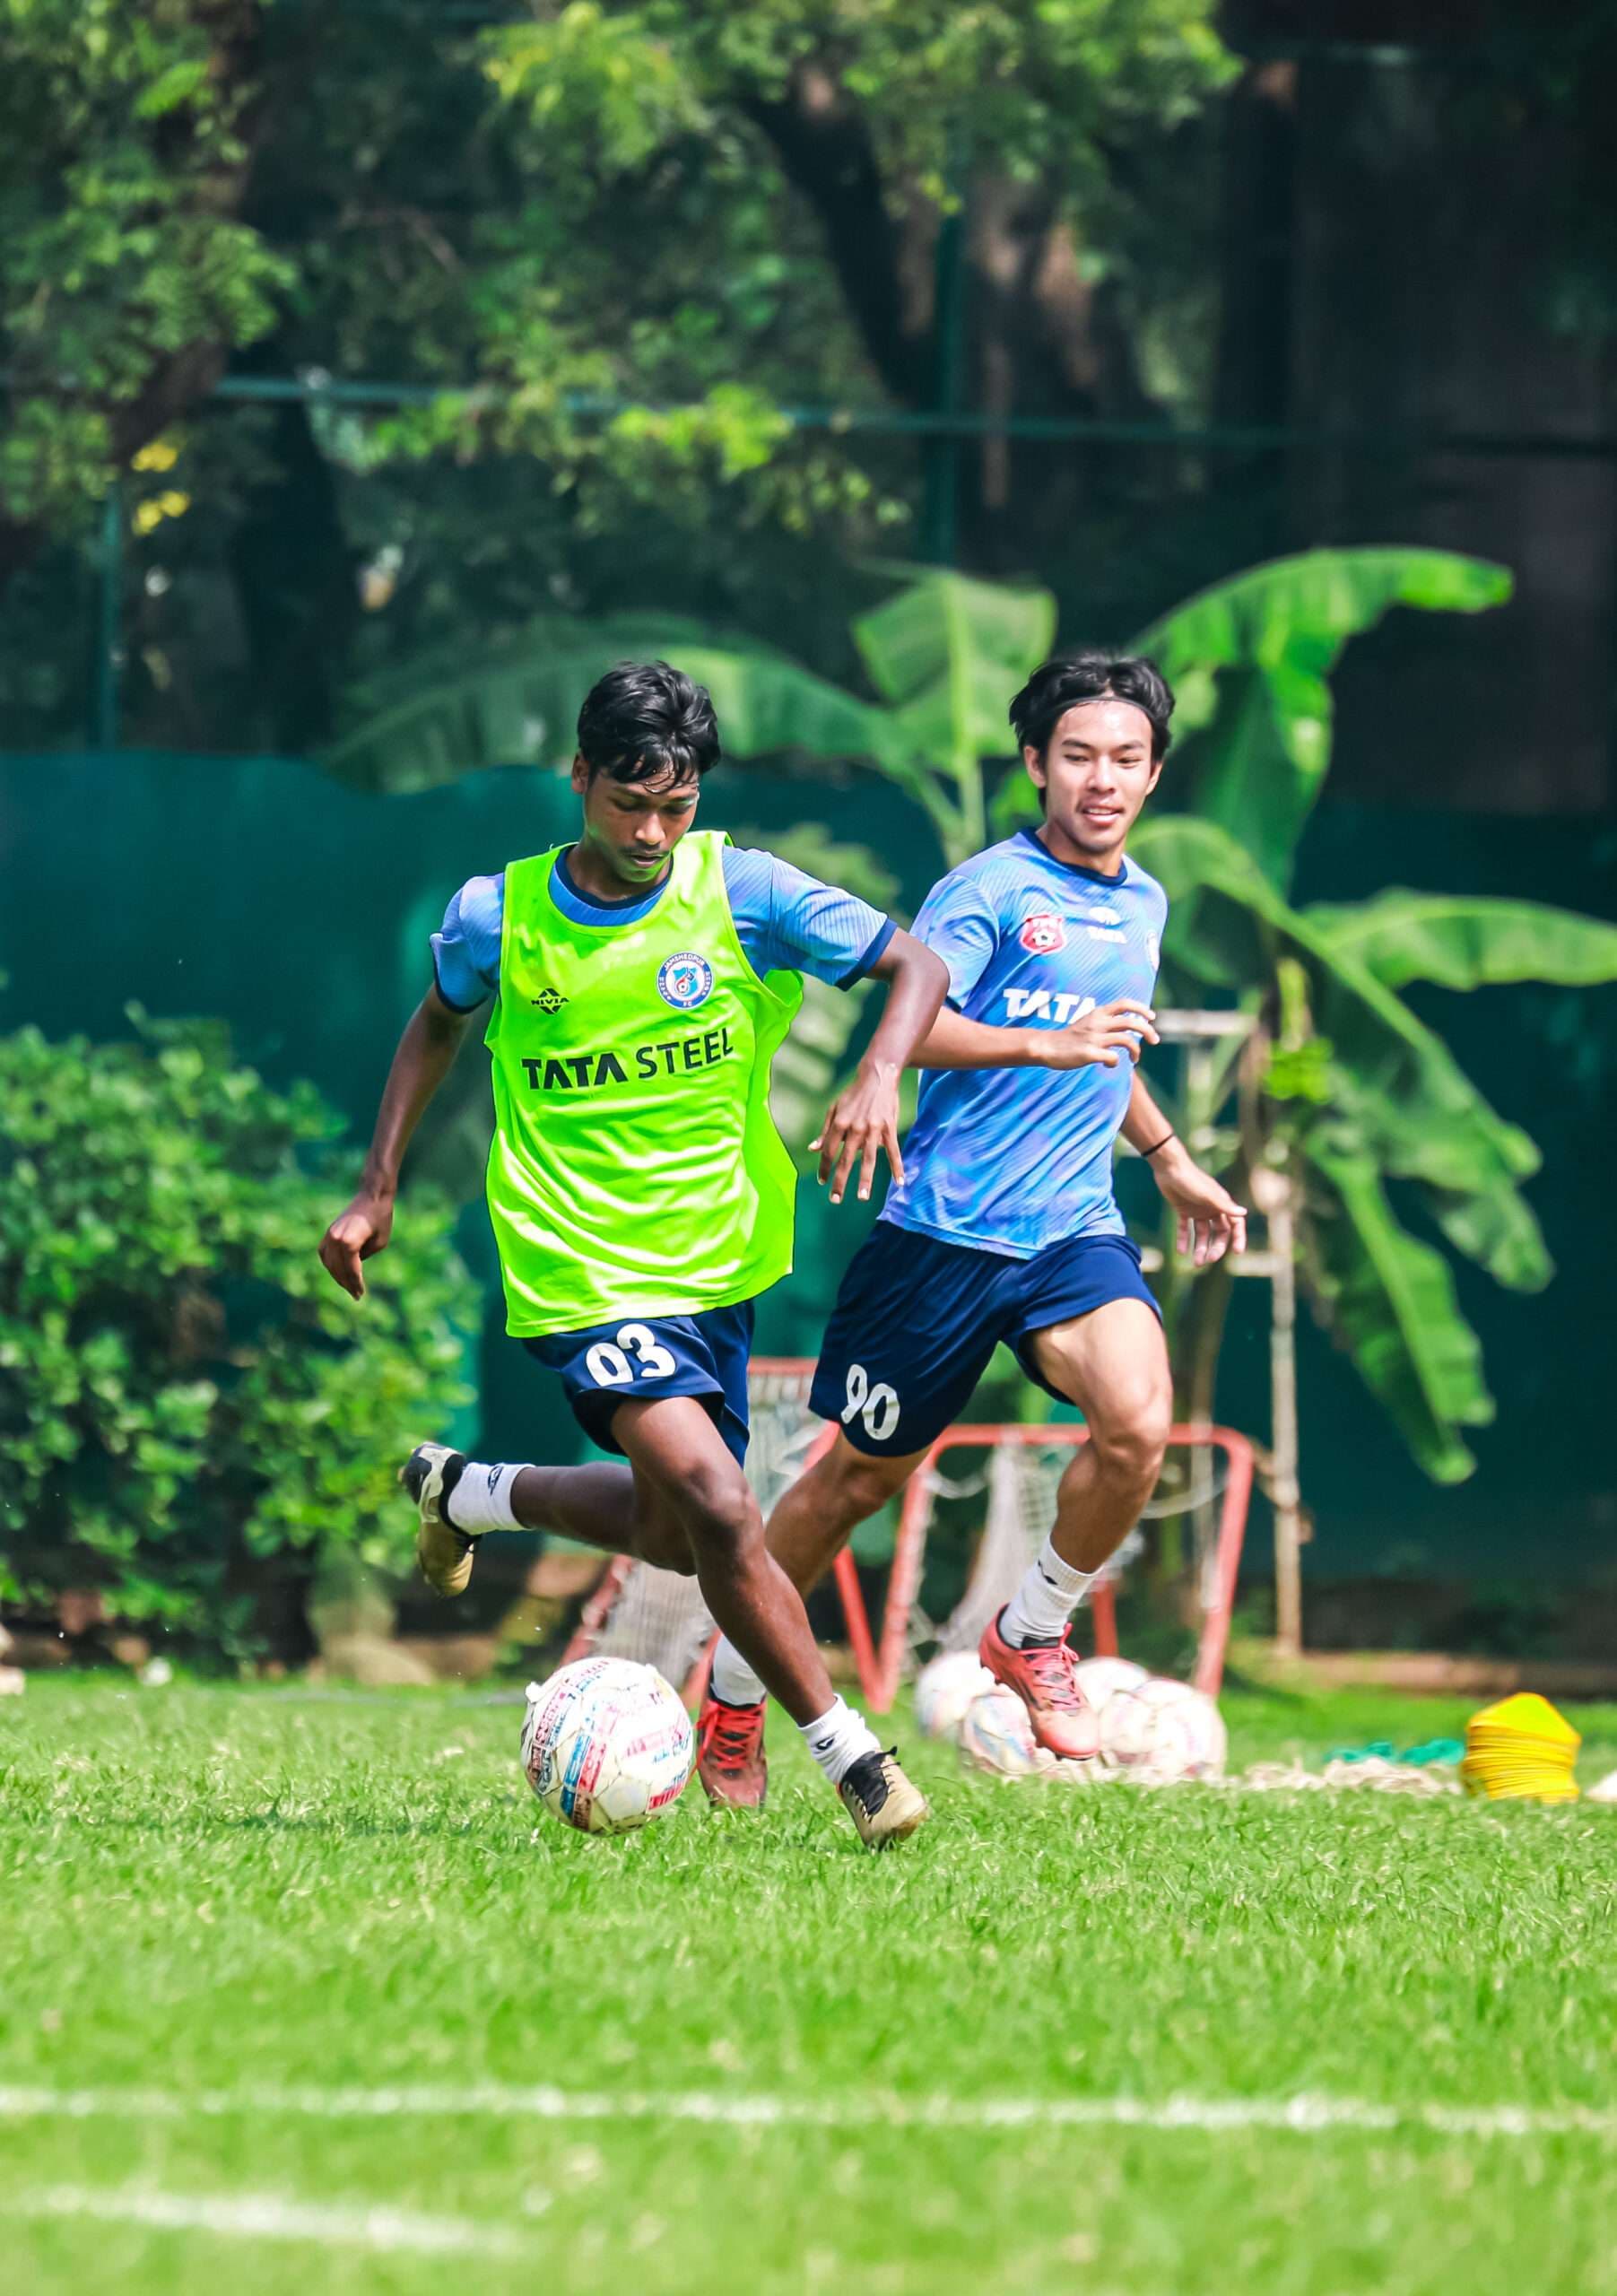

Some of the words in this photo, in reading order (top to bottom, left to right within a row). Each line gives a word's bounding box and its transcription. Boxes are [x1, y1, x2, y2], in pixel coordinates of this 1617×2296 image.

[530, 996, 569, 1005] NIVIA
[521, 1052, 629, 1091] TATA
[635, 1027, 734, 1079] STEEL
[586, 1323, 677, 1387] 03
[840, 1363, 900, 1441] 90
